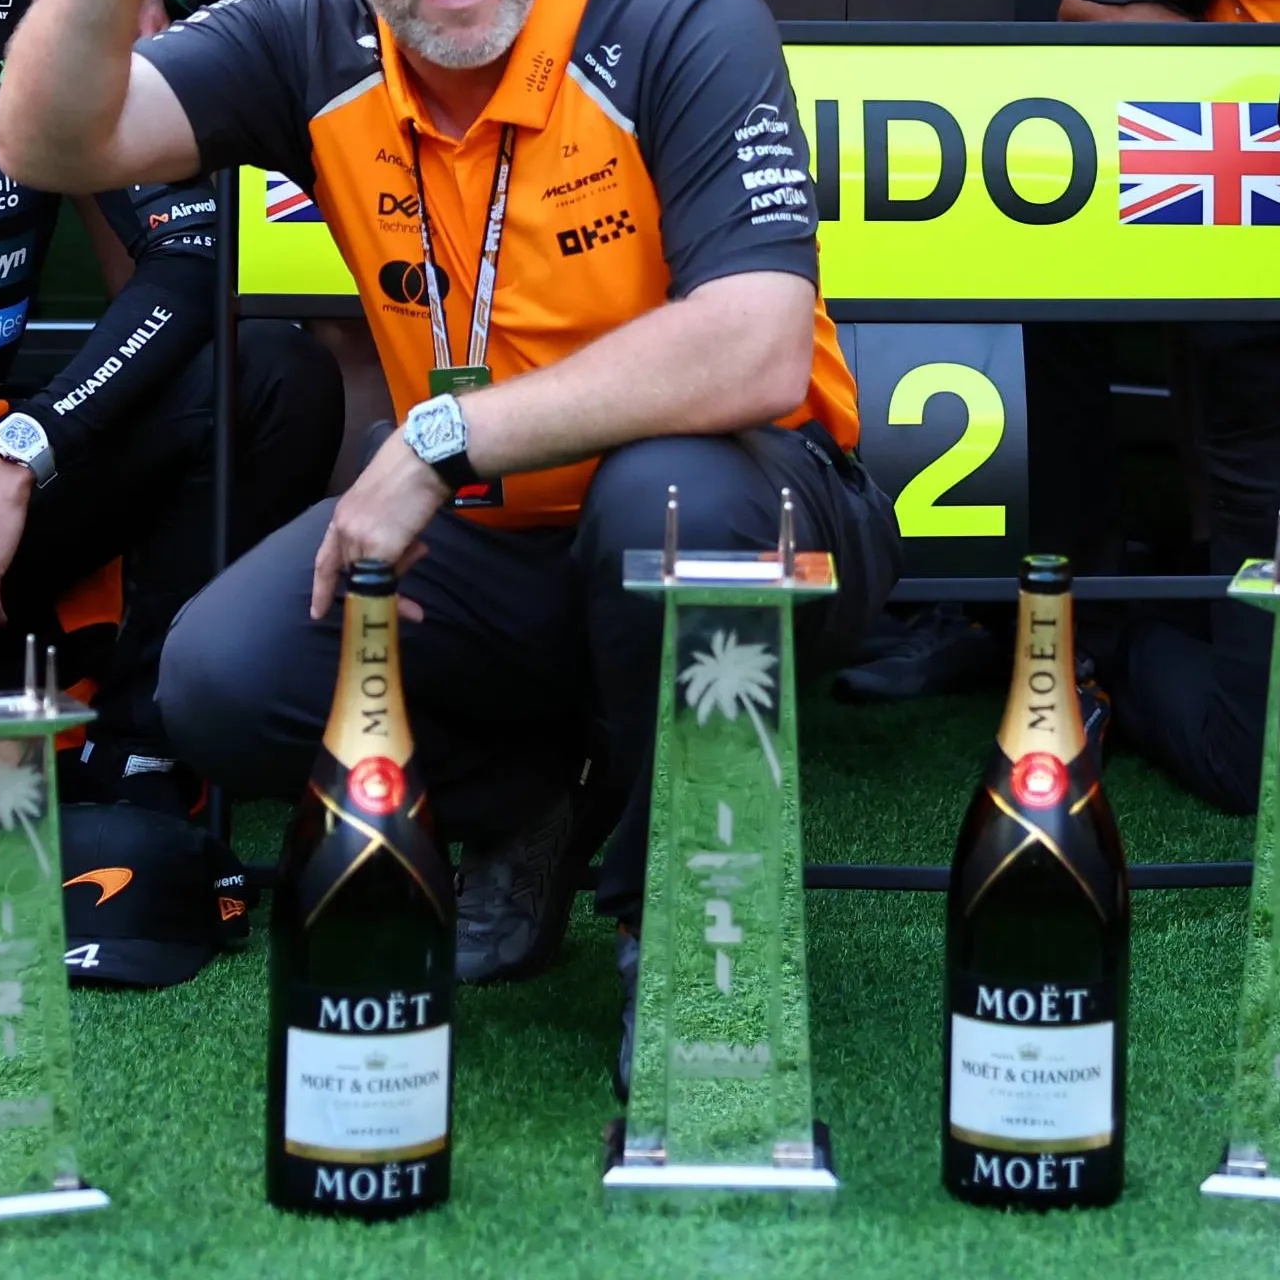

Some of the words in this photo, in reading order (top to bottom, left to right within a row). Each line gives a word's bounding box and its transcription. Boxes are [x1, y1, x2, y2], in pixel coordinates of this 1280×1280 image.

[536, 58, 554, 93] CISCO
[584, 54, 597, 67] DP
[593, 62, 618, 89] WORLD
[735, 118, 789, 141] workday
[541, 167, 613, 202] McLaren
[556, 209, 636, 257] OKX
[751, 213, 791, 225] RICHARD
[53, 357, 123, 416] RICHARD
[119, 305, 172, 359] MILLE
[886, 362, 1006, 537] 2
[361, 612, 389, 736] MOËT
[1027, 611, 1059, 733] MOËT
[64, 944, 100, 969] 4
[318, 990, 432, 1031] MOËT
[976, 983, 1089, 1021] MOËT
[301, 1073, 345, 1093] MOËT
[350, 1078, 362, 1094] &
[366, 1069, 440, 1094] CHANDON
[961, 1059, 999, 1081] MOËT
[1004, 1069, 1016, 1083] &
[1021, 1065, 1102, 1085] CHANDON
[314, 1162, 427, 1201] MOËT
[973, 1151, 1086, 1190] MOËT
